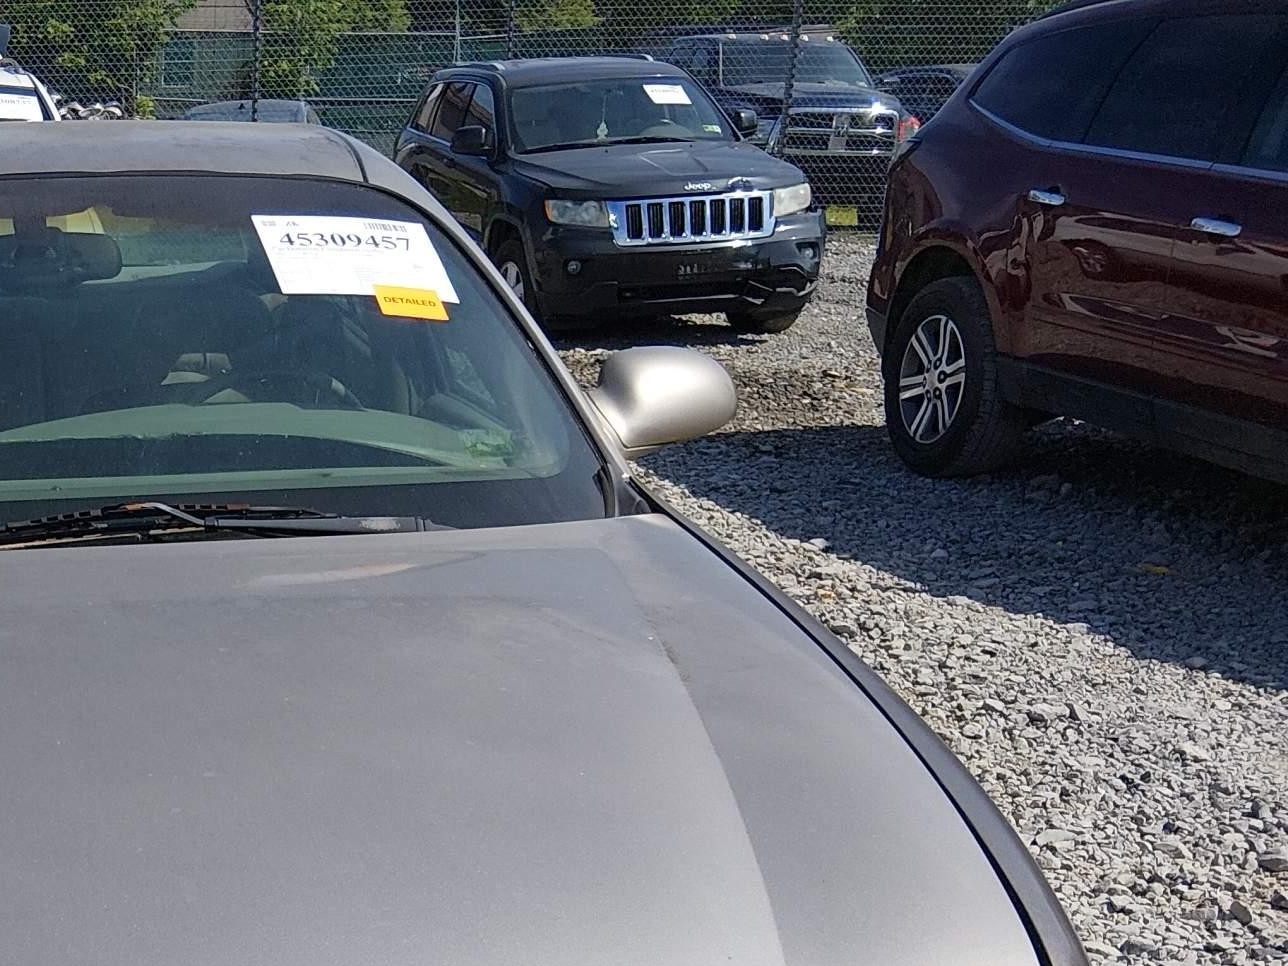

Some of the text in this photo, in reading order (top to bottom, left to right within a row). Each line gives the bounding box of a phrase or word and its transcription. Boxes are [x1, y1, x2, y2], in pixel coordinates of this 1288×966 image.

[684, 181, 712, 191] Jeep
[279, 233, 410, 251] 45309457
[383, 296, 437, 307] DETAILED
